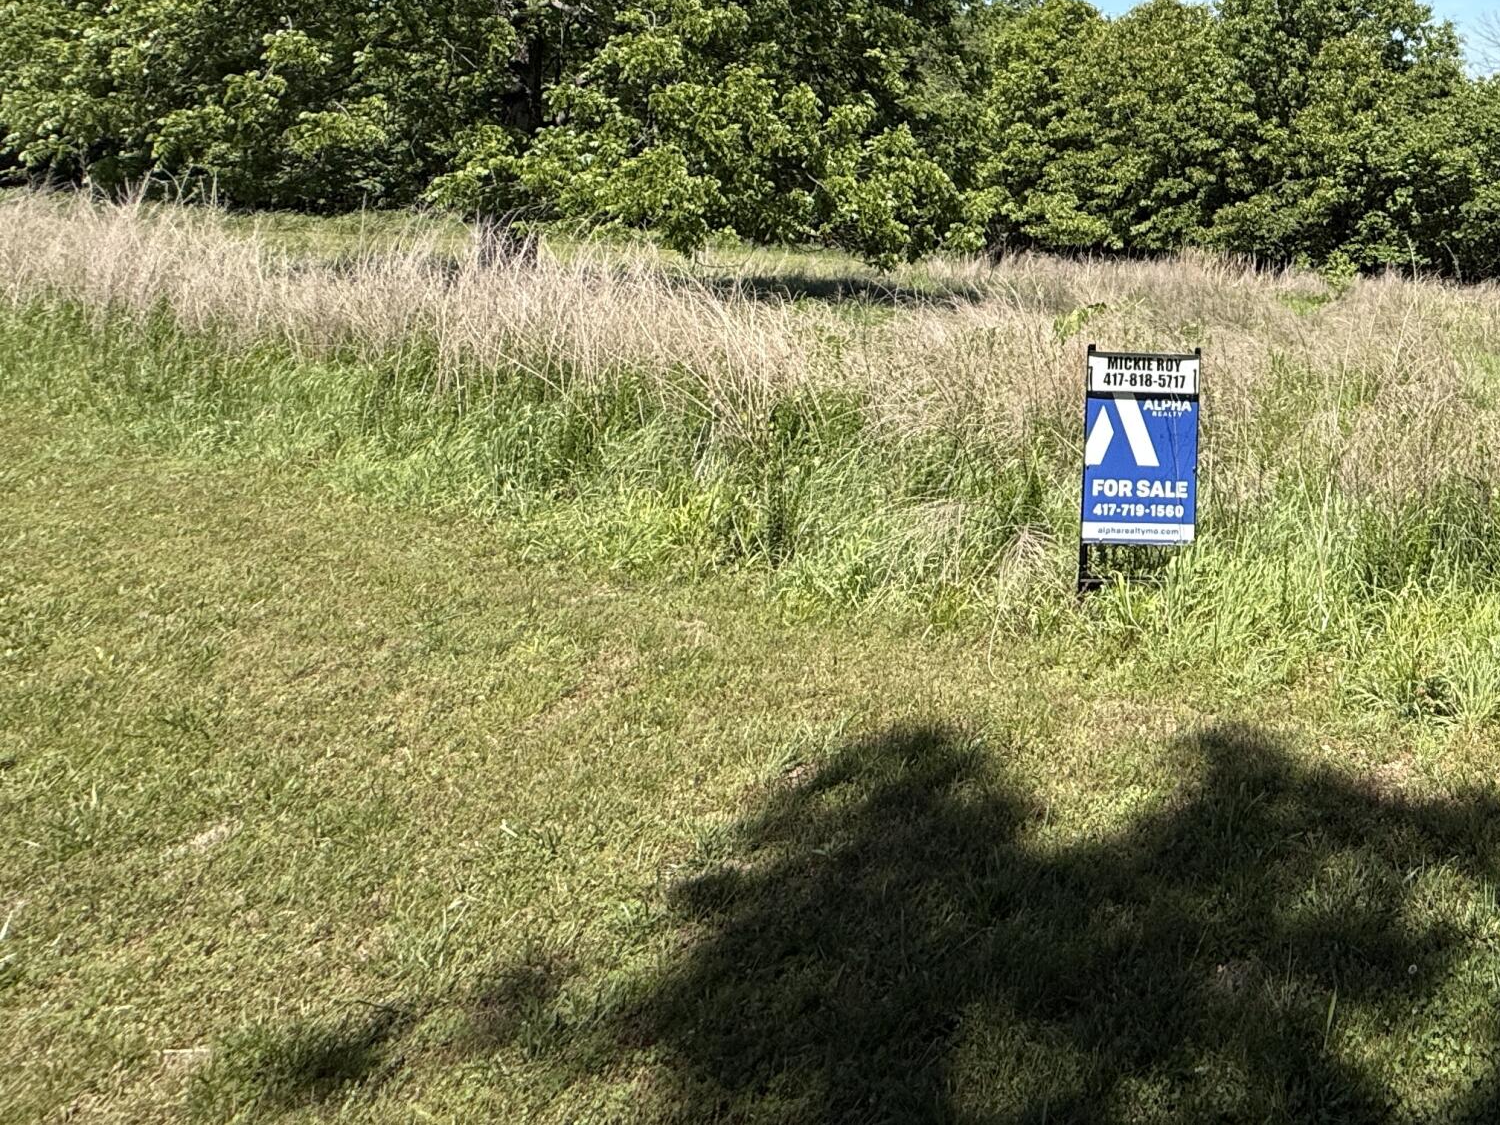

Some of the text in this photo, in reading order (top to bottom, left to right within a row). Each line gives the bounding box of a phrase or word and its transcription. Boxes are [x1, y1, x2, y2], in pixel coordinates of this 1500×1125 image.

[1107, 356, 1181, 372] MICKIE ROY
[1103, 372, 1185, 389] 417-818-5717
[1143, 399, 1192, 412] ALPHA
[1092, 479, 1188, 498] FOR SALE
[1097, 526, 1180, 535] alpharealtymo.com
